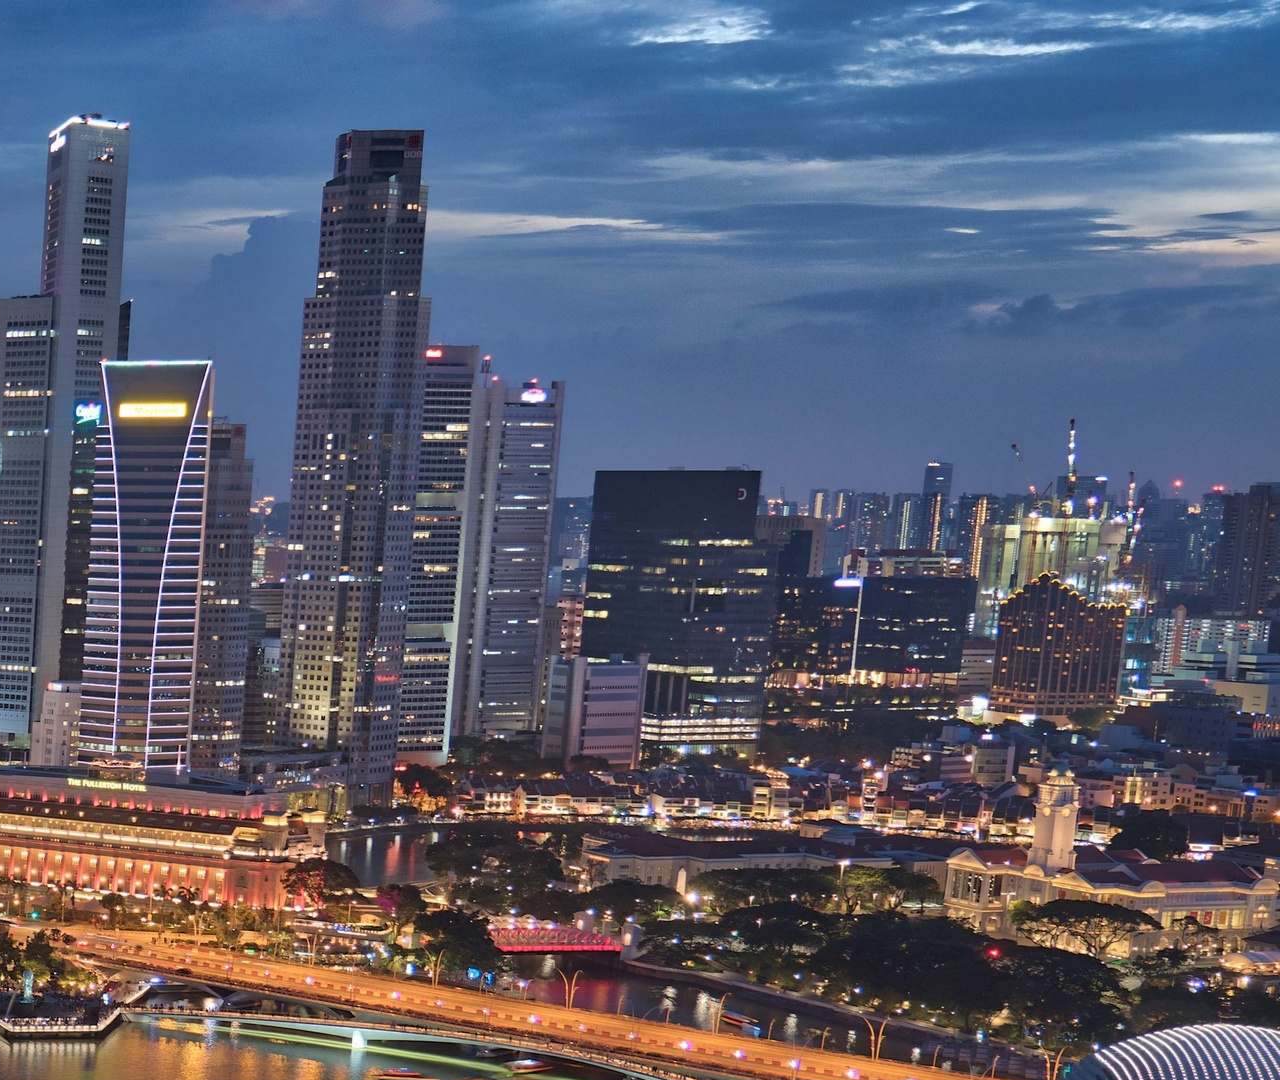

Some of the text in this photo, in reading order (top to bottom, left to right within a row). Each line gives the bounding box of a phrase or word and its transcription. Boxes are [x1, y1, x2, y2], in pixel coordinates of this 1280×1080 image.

[404, 150, 423, 158] UOB
[67, 778, 147, 792] THE FULLERTON HOTEL
